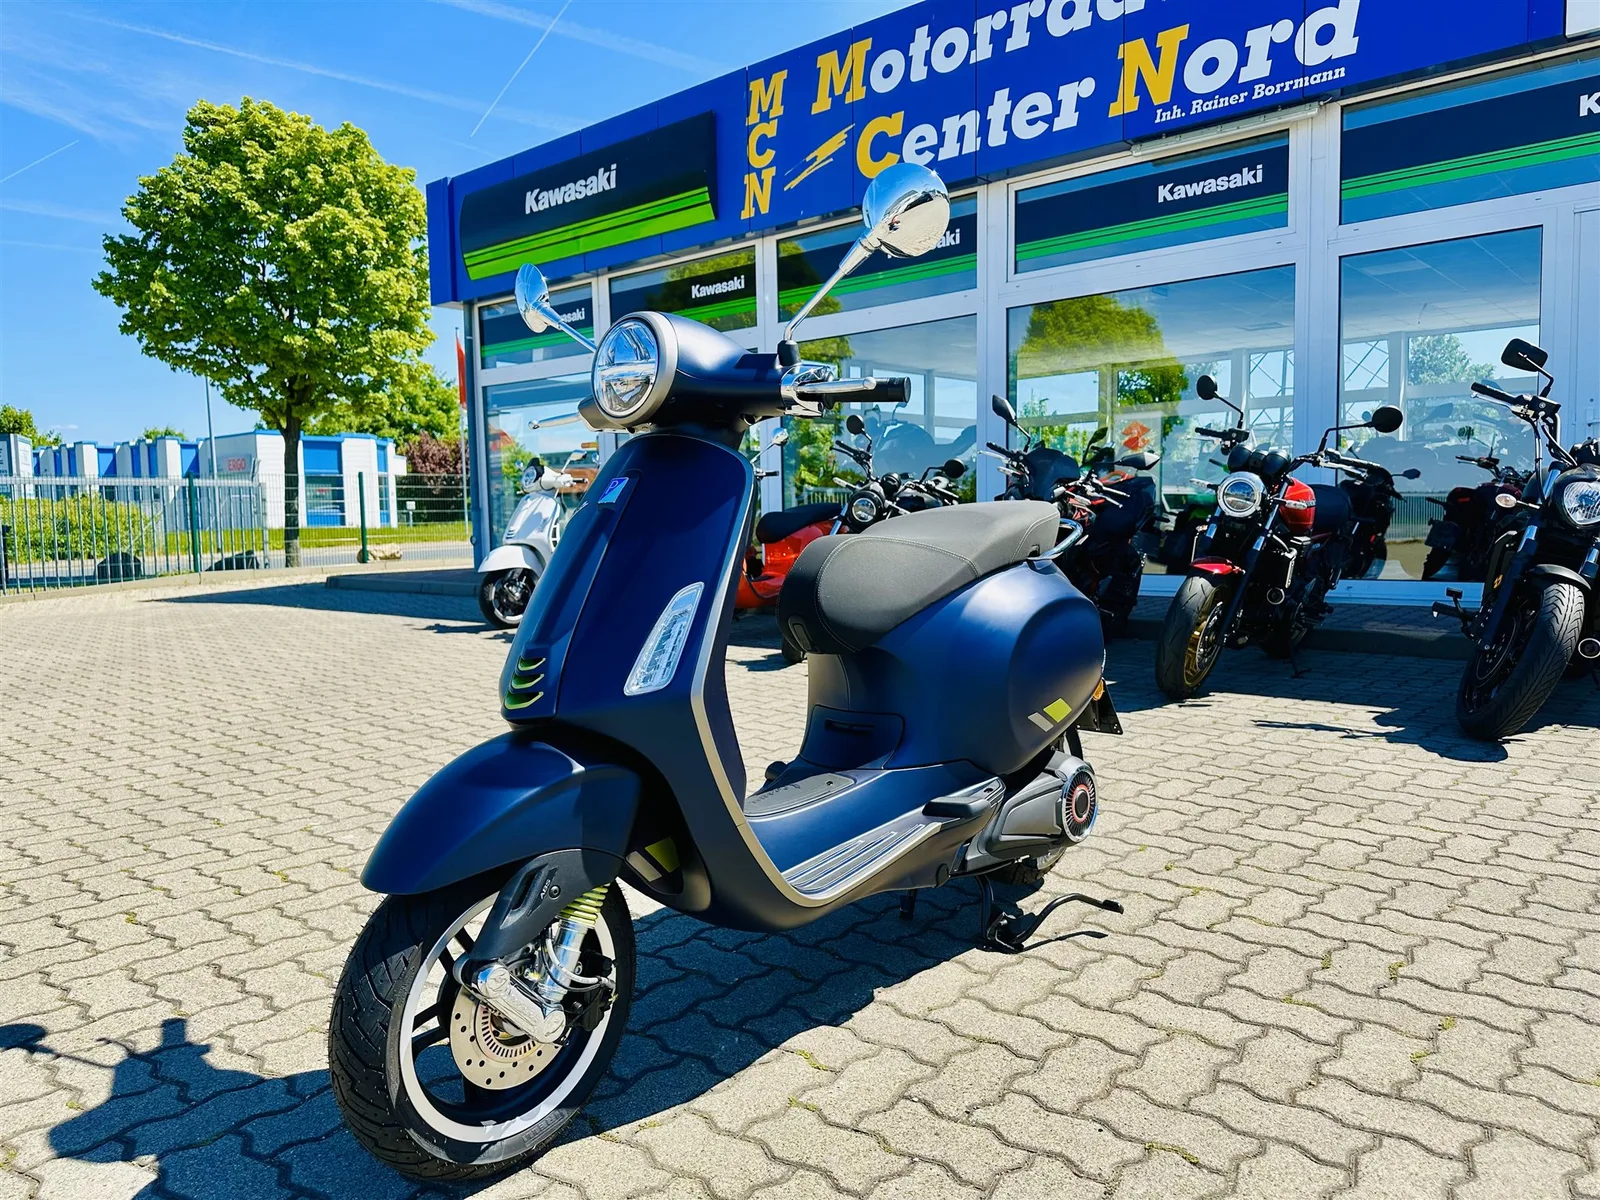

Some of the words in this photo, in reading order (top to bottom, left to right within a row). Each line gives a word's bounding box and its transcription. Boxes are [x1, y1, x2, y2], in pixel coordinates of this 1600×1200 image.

[856, 77, 1096, 179] Center
[1108, 0, 1360, 118] Nord
[1154, 107, 1186, 123] Inh.
[1190, 91, 1248, 115] Rainer
[1252, 66, 1346, 99] Borrmann
[525, 163, 617, 215] Kawasaki
[1157, 163, 1263, 203] Kawasaki
[691, 274, 745, 299] Kawasaki
[228, 458, 246, 471] ERGO
